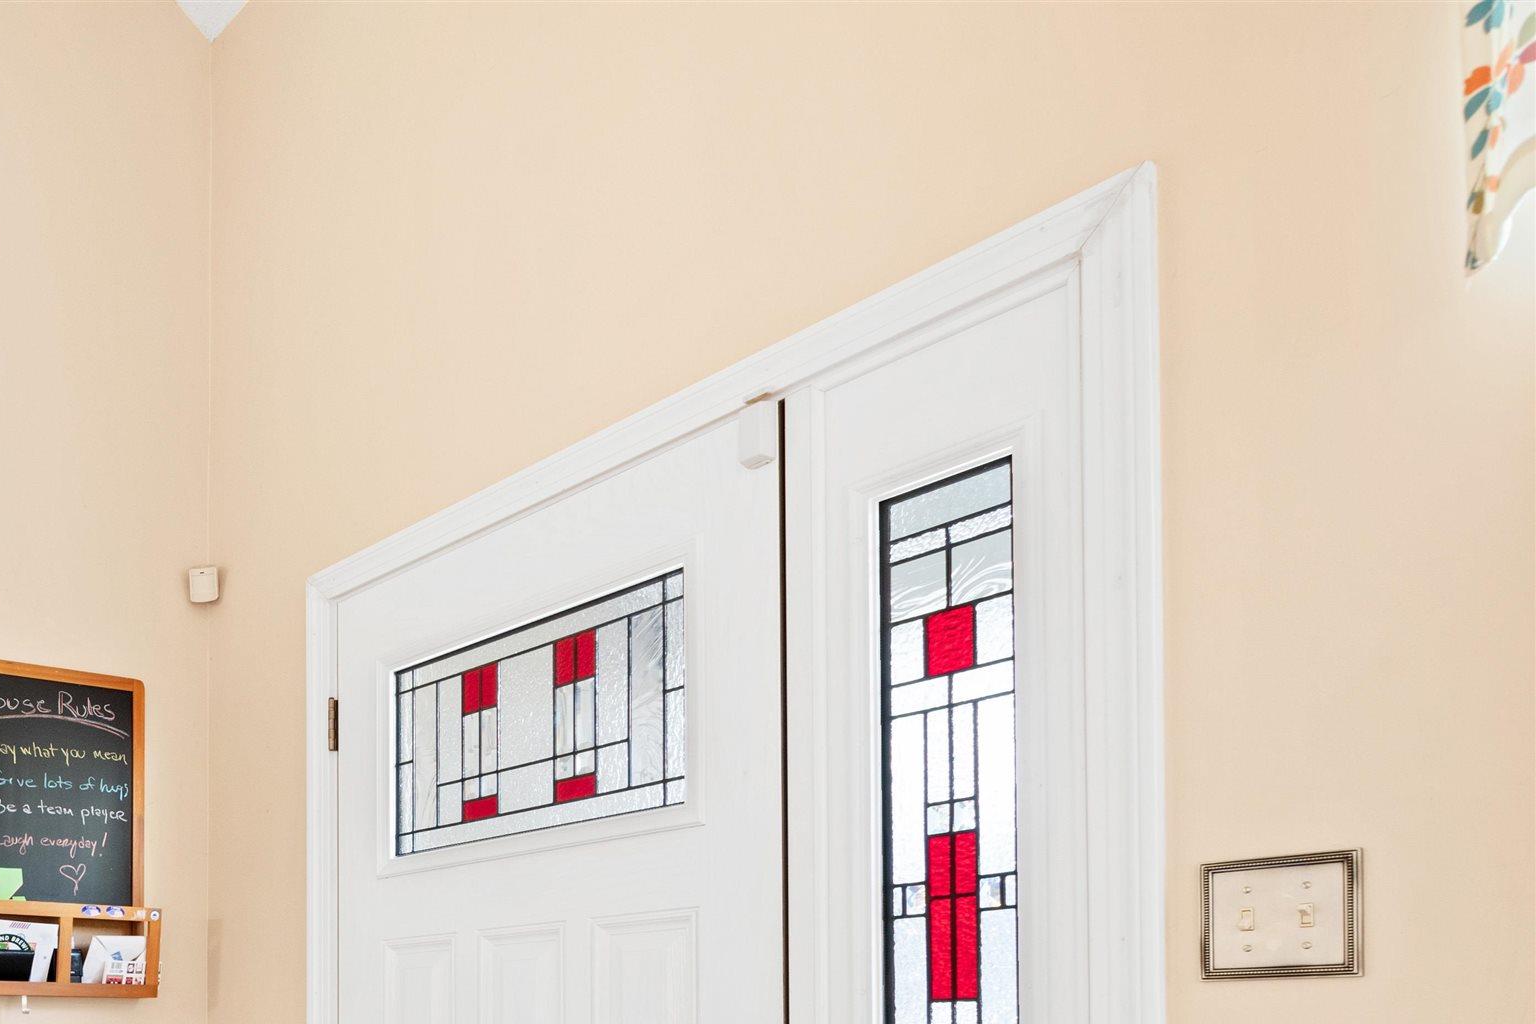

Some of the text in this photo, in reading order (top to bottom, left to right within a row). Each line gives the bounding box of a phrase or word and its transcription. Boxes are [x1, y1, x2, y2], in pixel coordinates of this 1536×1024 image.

[58, 690, 115, 720] Rules
[20, 742, 58, 759] what
[58, 747, 86, 767] you
[93, 749, 128, 765] mean
[44, 774, 72, 789] lots
[79, 777, 95, 791] of
[100, 779, 129, 801] hugs
[22, 801, 32, 814] a
[38, 799, 74, 816] team
